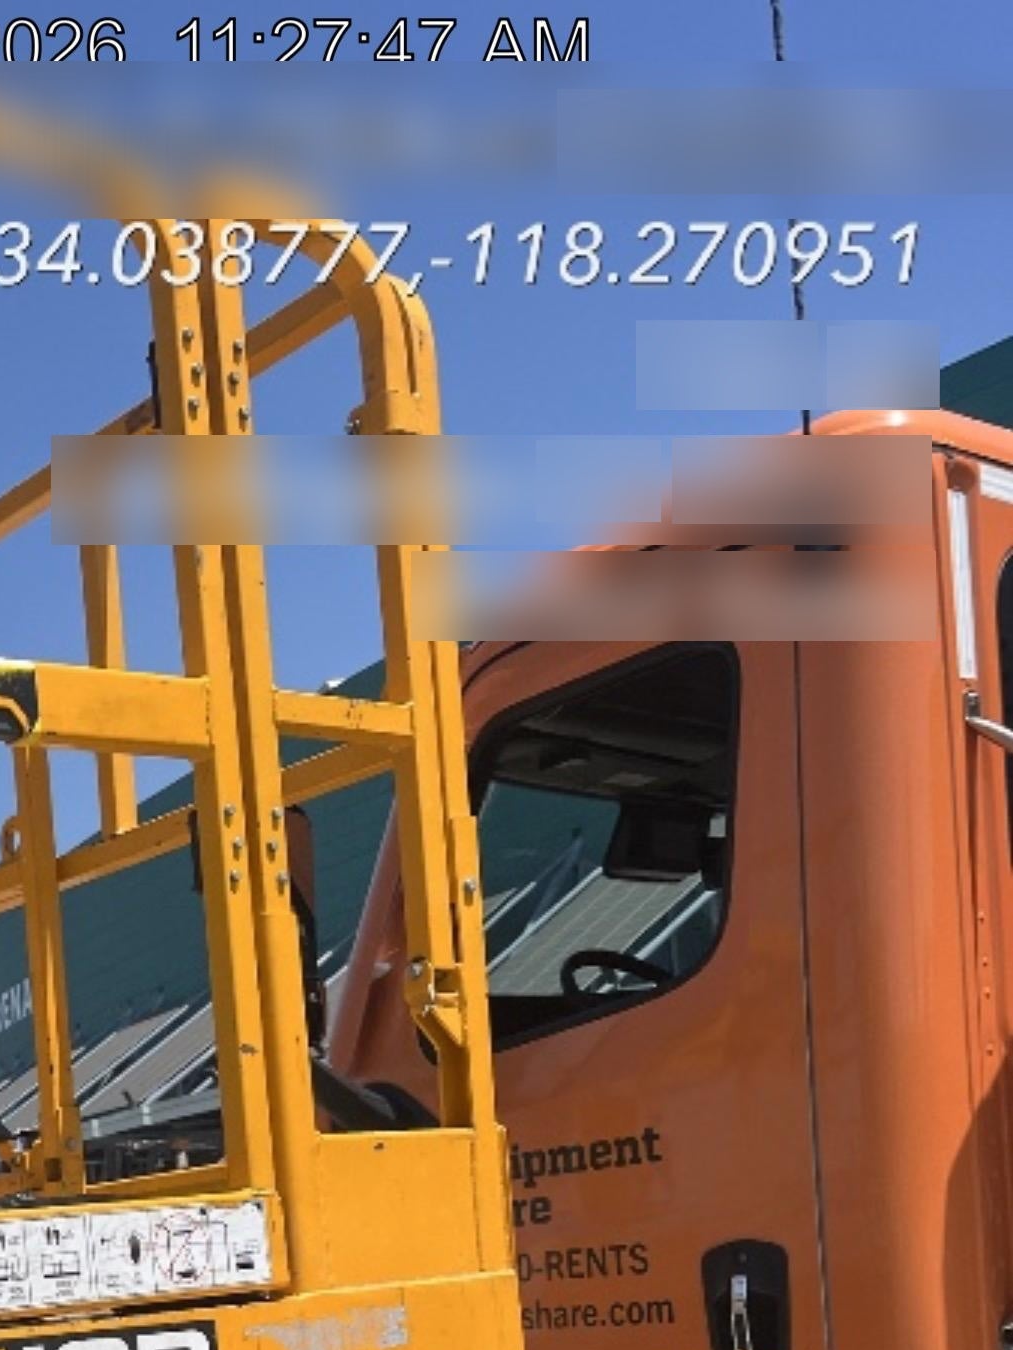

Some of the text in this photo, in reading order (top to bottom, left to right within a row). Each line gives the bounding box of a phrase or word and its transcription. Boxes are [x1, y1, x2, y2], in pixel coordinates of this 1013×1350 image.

[510, 1128, 662, 1187] ipment
[517, 1243, 649, 1282] 0-RENTS
[522, 1298, 675, 1330] share.com
